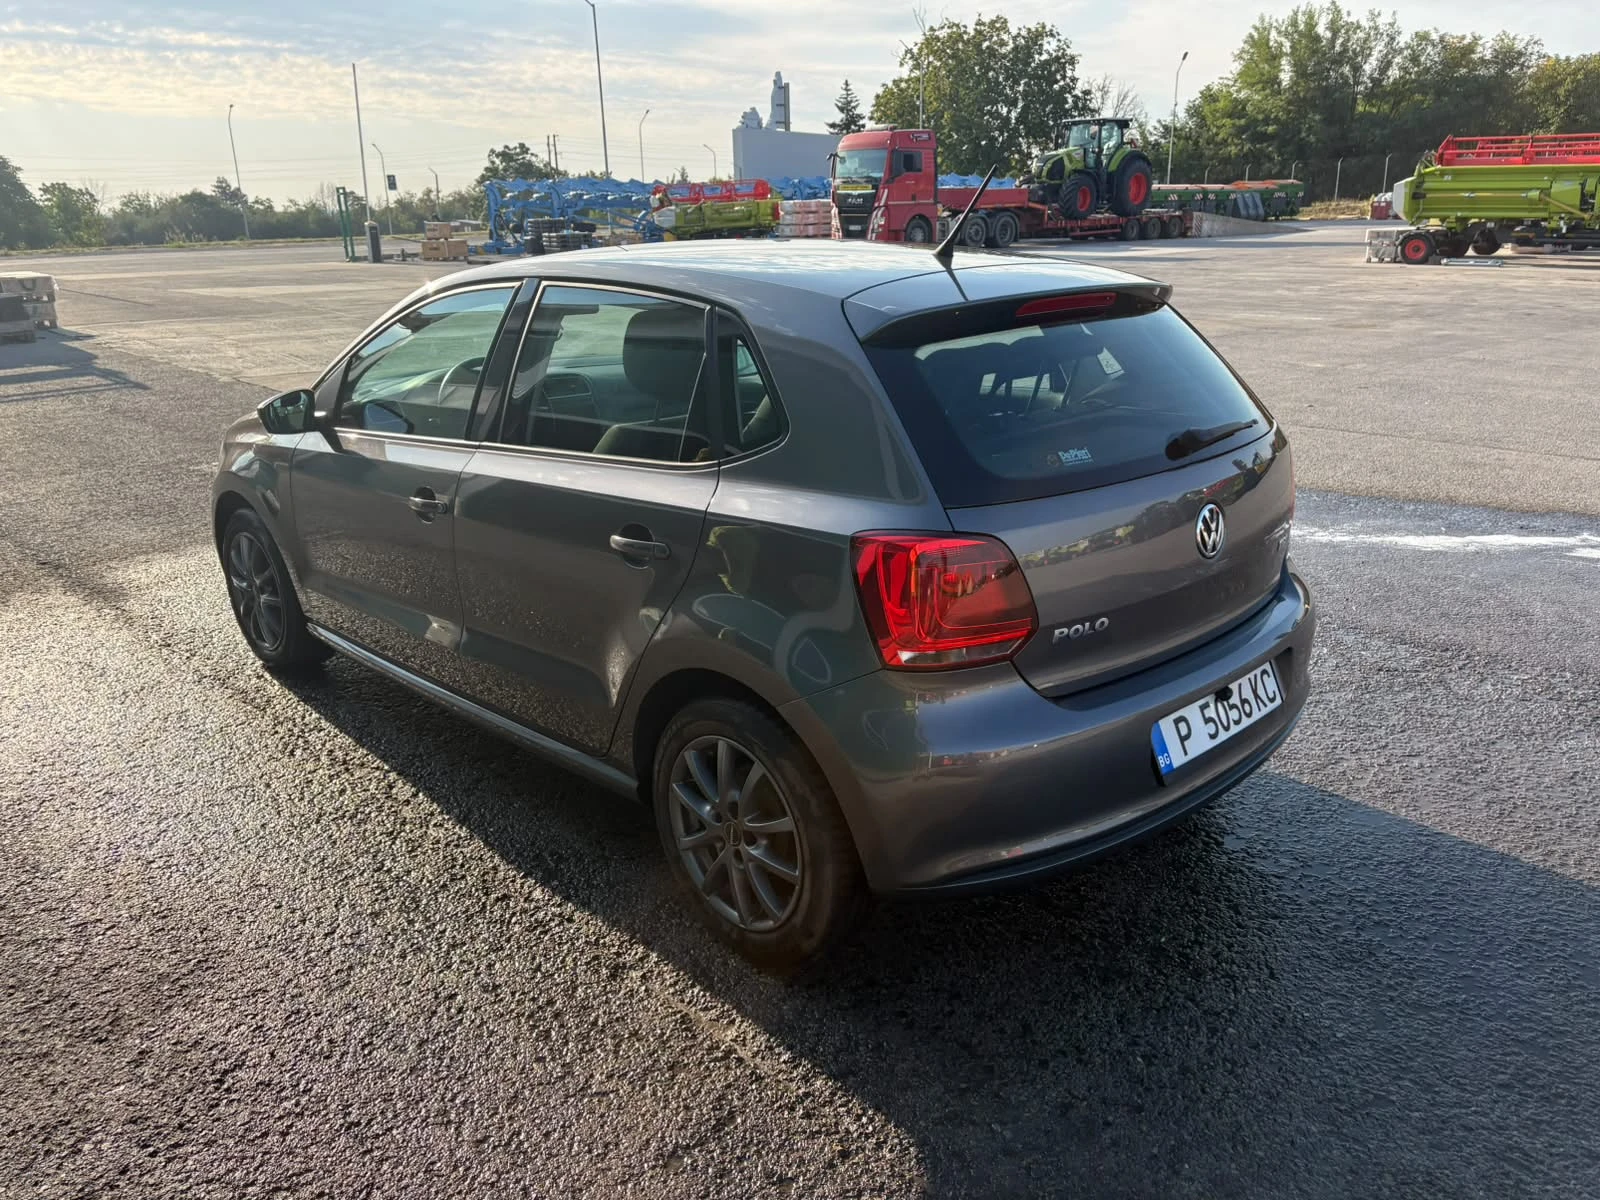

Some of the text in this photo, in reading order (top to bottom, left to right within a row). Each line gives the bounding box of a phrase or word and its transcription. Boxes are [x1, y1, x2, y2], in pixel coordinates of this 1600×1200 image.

[1052, 617, 1109, 644] POLO
[1173, 715, 1192, 756] P
[1158, 753, 1170, 767] BG
